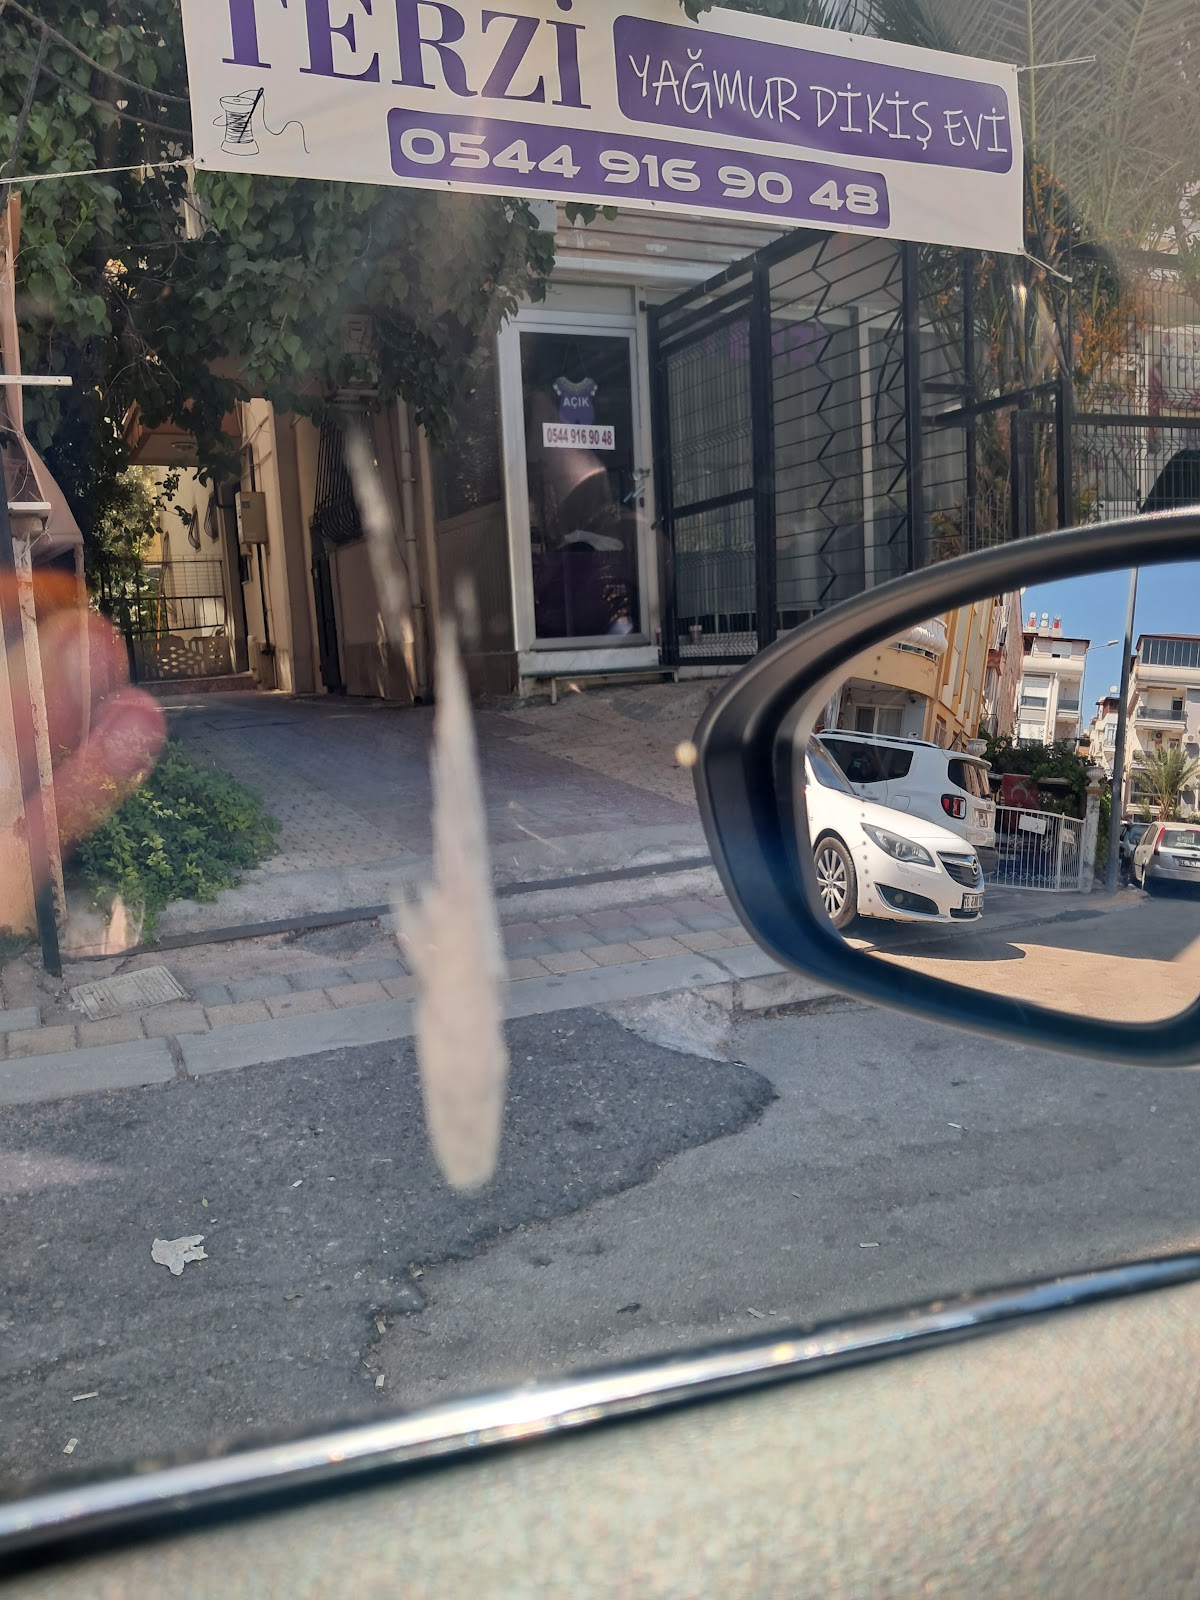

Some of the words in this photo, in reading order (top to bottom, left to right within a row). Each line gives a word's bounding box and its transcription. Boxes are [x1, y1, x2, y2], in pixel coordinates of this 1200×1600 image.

[222, 0, 591, 109] TERZİ
[628, 48, 801, 124] YAĞMUR
[810, 83, 932, 150] DİKİŞ
[943, 107, 1008, 153] EVİ
[400, 128, 581, 179] 0544
[599, 150, 701, 192] 916
[717, 166, 793, 204] 90
[809, 180, 879, 215] 48
[547, 428, 568, 443] 0544
[570, 429, 586, 444] 916
[588, 430, 599, 444] 90
[601, 430, 612, 445] 48
[563, 397, 590, 409] AÇIK
